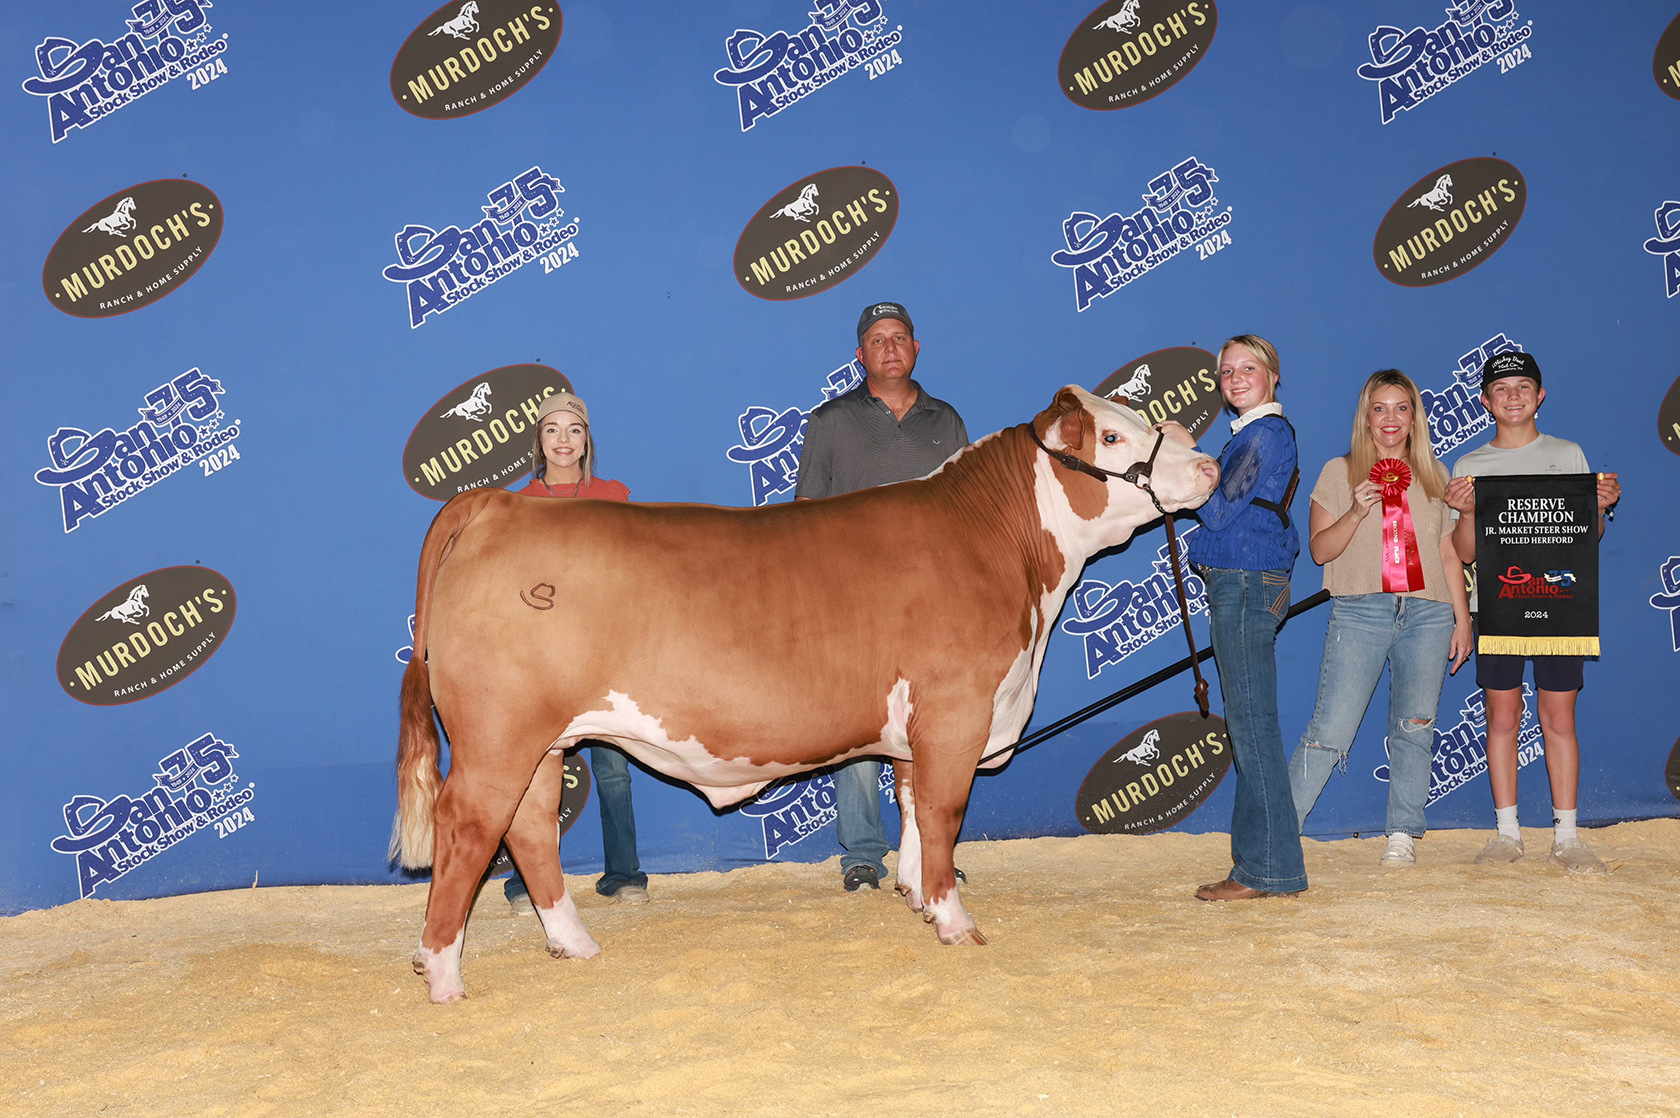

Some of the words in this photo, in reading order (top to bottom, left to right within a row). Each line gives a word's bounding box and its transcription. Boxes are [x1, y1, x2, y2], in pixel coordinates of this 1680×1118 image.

[22, 33, 145, 95] San
[89, 93, 130, 119] Stock
[129, 75, 168, 98] Show
[168, 65, 180, 78] &
[181, 39, 227, 70] Rodeo
[187, 58, 228, 91] 2024
[407, 6, 550, 104] MURDOCH'S
[714, 25, 826, 85] San
[737, 27, 864, 132] Antonio
[775, 83, 813, 108] Stock
[812, 65, 848, 88] Show
[847, 56, 859, 69] &
[859, 31, 902, 60] Rodeo
[865, 49, 903, 80] 2024
[1074, 2, 1205, 95] MURDOCH'S
[1108, 88, 1138, 102] RANCH
[1149, 69, 1172, 87] HOME
[1173, 43, 1199, 71] SUPPLY
[1357, 21, 1462, 80] San
[1379, 23, 1497, 125] Antonio
[1413, 77, 1449, 102] Stock
[1448, 59, 1481, 81] Show
[1481, 51, 1491, 63] &
[1492, 26, 1532, 55] Rodeo
[1497, 43, 1532, 74] 2024
[48, 35, 186, 143] Antonio
[445, 96, 477, 111] RANCH
[489, 76, 514, 95] HOME
[515, 49, 543, 77] SUPPLY
[60, 202, 210, 302] MURDOCH'S
[383, 219, 500, 282] San
[750, 188, 887, 286] MURDOCH'S
[1051, 207, 1159, 267] San
[1110, 264, 1146, 289] Stock
[1145, 246, 1179, 268] Show
[1179, 237, 1190, 249] &
[1190, 212, 1231, 241] Rodeo
[1196, 229, 1232, 261] 2024
[1388, 179, 1515, 273] MURDOCH'S
[1421, 265, 1450, 279] RANCH
[1460, 246, 1483, 263] HOME
[1484, 220, 1508, 247] SUPPLY
[100, 294, 133, 309] RANCH
[146, 274, 172, 293] HOME
[173, 246, 202, 275] SUPPLY
[407, 220, 540, 329] Antonio
[446, 278, 486, 304] Stock
[485, 259, 522, 283] Show
[521, 250, 534, 263] &
[534, 223, 579, 254] Rodeo
[540, 241, 580, 274] 2024
[786, 277, 817, 292] RANCH
[828, 258, 852, 276] HOME
[853, 231, 880, 259] SUPPLY
[1074, 209, 1196, 312] Antonio
[35, 421, 158, 485] San
[1187, 410, 1209, 434] UPPLY
[1433, 436, 1456, 460] ock
[1455, 421, 1488, 443] Show
[60, 423, 199, 533] Antonio
[101, 481, 143, 508] Stock
[142, 462, 181, 486] Show
[180, 452, 193, 466] &
[193, 425, 240, 457] Rodeo
[199, 444, 241, 477] 2024
[457, 477, 489, 493] RANCH
[501, 457, 526, 476] HOME
[1485, 526, 1497, 536] JR.
[1498, 526, 1534, 534] MARKET
[1534, 526, 1560, 534] STEER
[1562, 526, 1588, 534] SHOW
[1498, 511, 1574, 524] CHAMPION
[1507, 498, 1566, 511] RESERVE
[1500, 536, 1530, 544] POLLED
[1531, 536, 1574, 544] HEREFORD
[1062, 573, 1169, 635] San
[1498, 565, 1546, 586] San
[1498, 584, 1559, 599] Antonio
[74, 588, 223, 691] MURDOCH'S
[1120, 630, 1156, 656] Stock
[1524, 610, 1549, 619] 2024
[114, 681, 147, 697] RANCH
[160, 660, 186, 679] HOME
[187, 632, 216, 661] SUPPLY
[1092, 733, 1223, 826] MURDOCH'S
[1125, 817, 1154, 831] RANCH
[1165, 798, 1188, 816] HOME
[1190, 773, 1215, 799] SUPPLY
[1428, 776, 1463, 801] Stock
[1462, 763, 1488, 780] Sho
[51, 787, 172, 853] San
[76, 787, 213, 899] Antonio
[117, 846, 158, 873] Stock
[157, 825, 195, 850] Show
[195, 816, 208, 829] &
[208, 788, 254, 820] Rodeo
[214, 806, 255, 839] 2024
[762, 785, 837, 861] Anto
[798, 810, 835, 836] Stock
